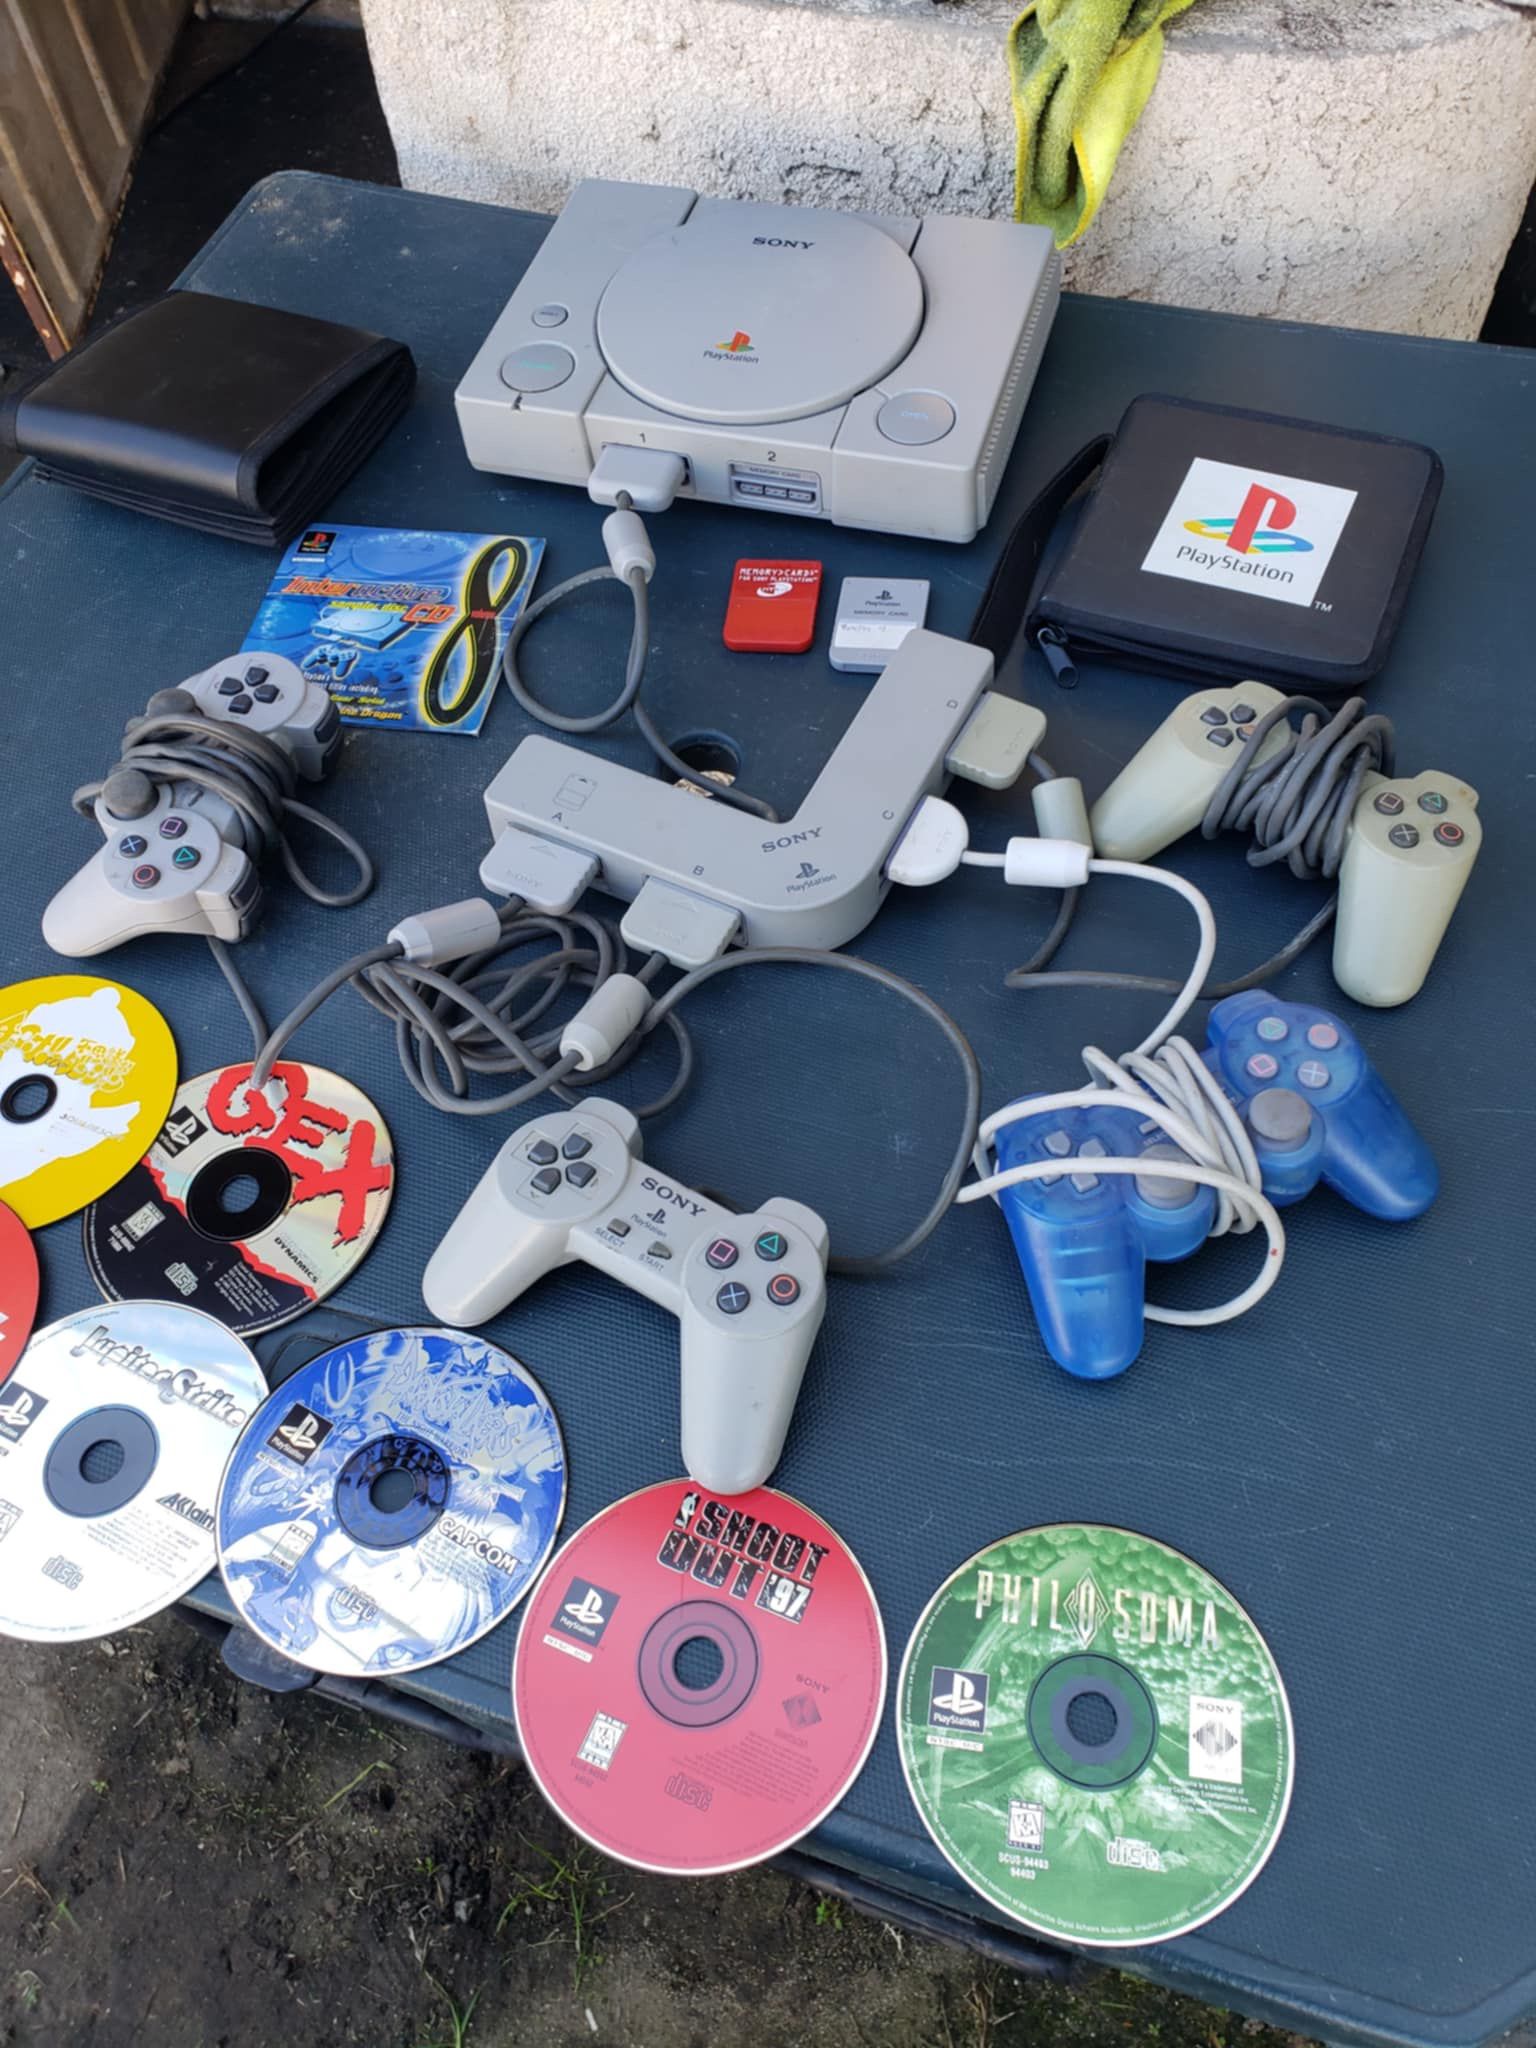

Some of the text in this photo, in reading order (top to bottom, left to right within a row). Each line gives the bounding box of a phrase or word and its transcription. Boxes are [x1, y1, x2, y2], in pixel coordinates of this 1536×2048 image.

[752, 236, 815, 249] SONY
[703, 350, 759, 363] PlayStation
[639, 432, 647, 443] 1
[767, 451, 778, 462] 2
[1176, 546, 1295, 584] PlayStation
[282, 576, 446, 603] Interactive
[402, 603, 457, 624] CD
[1314, 600, 1333, 613] TM
[946, 700, 959, 709] D
[552, 812, 563, 822] A
[882, 810, 894, 820] C
[761, 826, 823, 852] SONY
[692, 865, 705, 876] B
[786, 873, 838, 893] PlayStation
[206, 1061, 392, 1247] GEX
[641, 1177, 707, 1216] SONY
[594, 1226, 625, 1248] SELECT
[274, 1237, 319, 1283] DYNAMICS
[638, 1253, 664, 1272] START
[438, 1516, 522, 1577] CAPCOM
[694, 1500, 830, 1584] SHOOT
[656, 1529, 812, 1618] OUT '97
[560, 1615, 596, 1639] PlayStation
[796, 1673, 831, 1694] SONY
[1196, 1702, 1235, 1714] SONY
[933, 1712, 981, 1729] PlayStation
